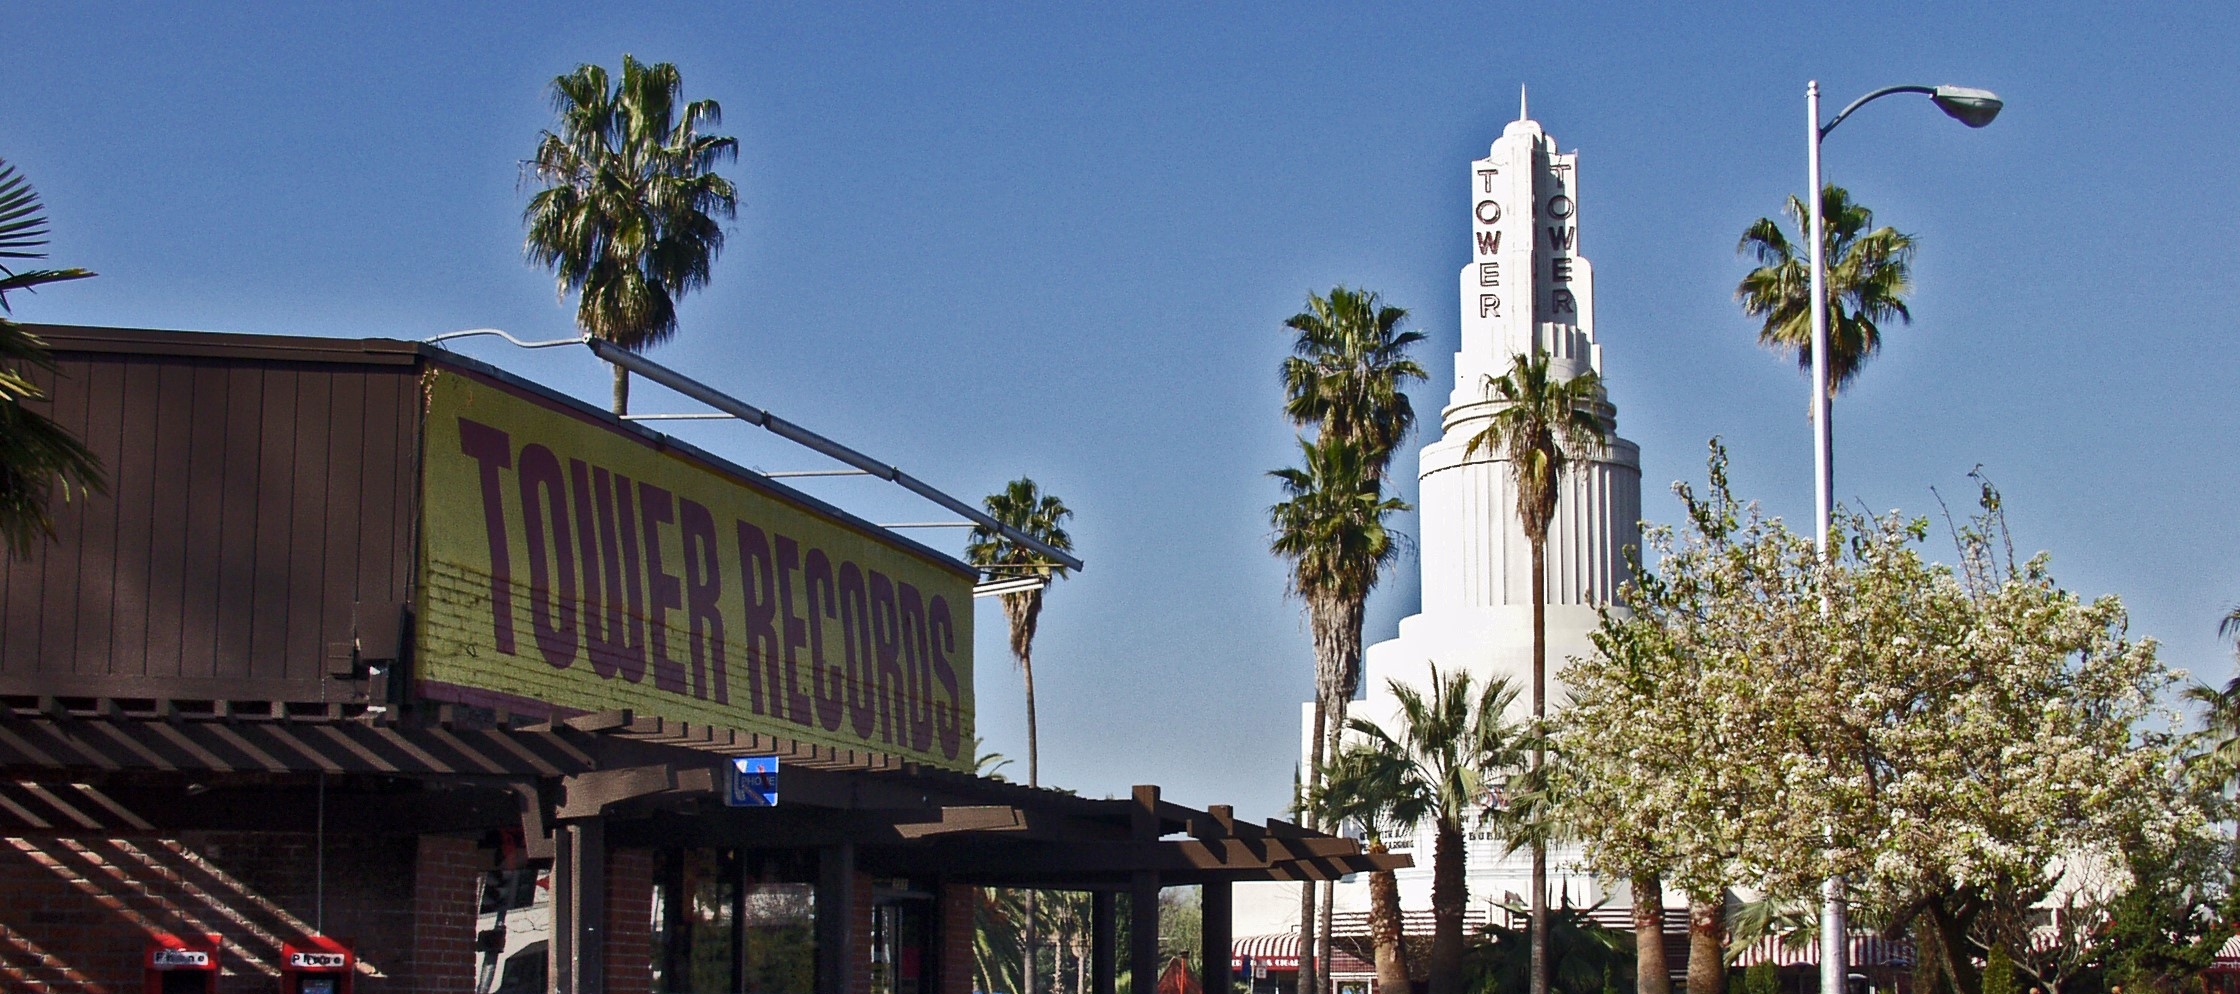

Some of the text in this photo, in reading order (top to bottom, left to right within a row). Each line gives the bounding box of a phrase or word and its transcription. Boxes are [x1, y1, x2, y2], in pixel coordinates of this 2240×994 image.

[1475, 168, 1502, 318] TOWER
[1547, 164, 1575, 313] TOWER
[457, 416, 960, 761] TOWER RECORDS
[741, 776, 775, 786] PHOE
[155, 952, 205, 962] Phne
